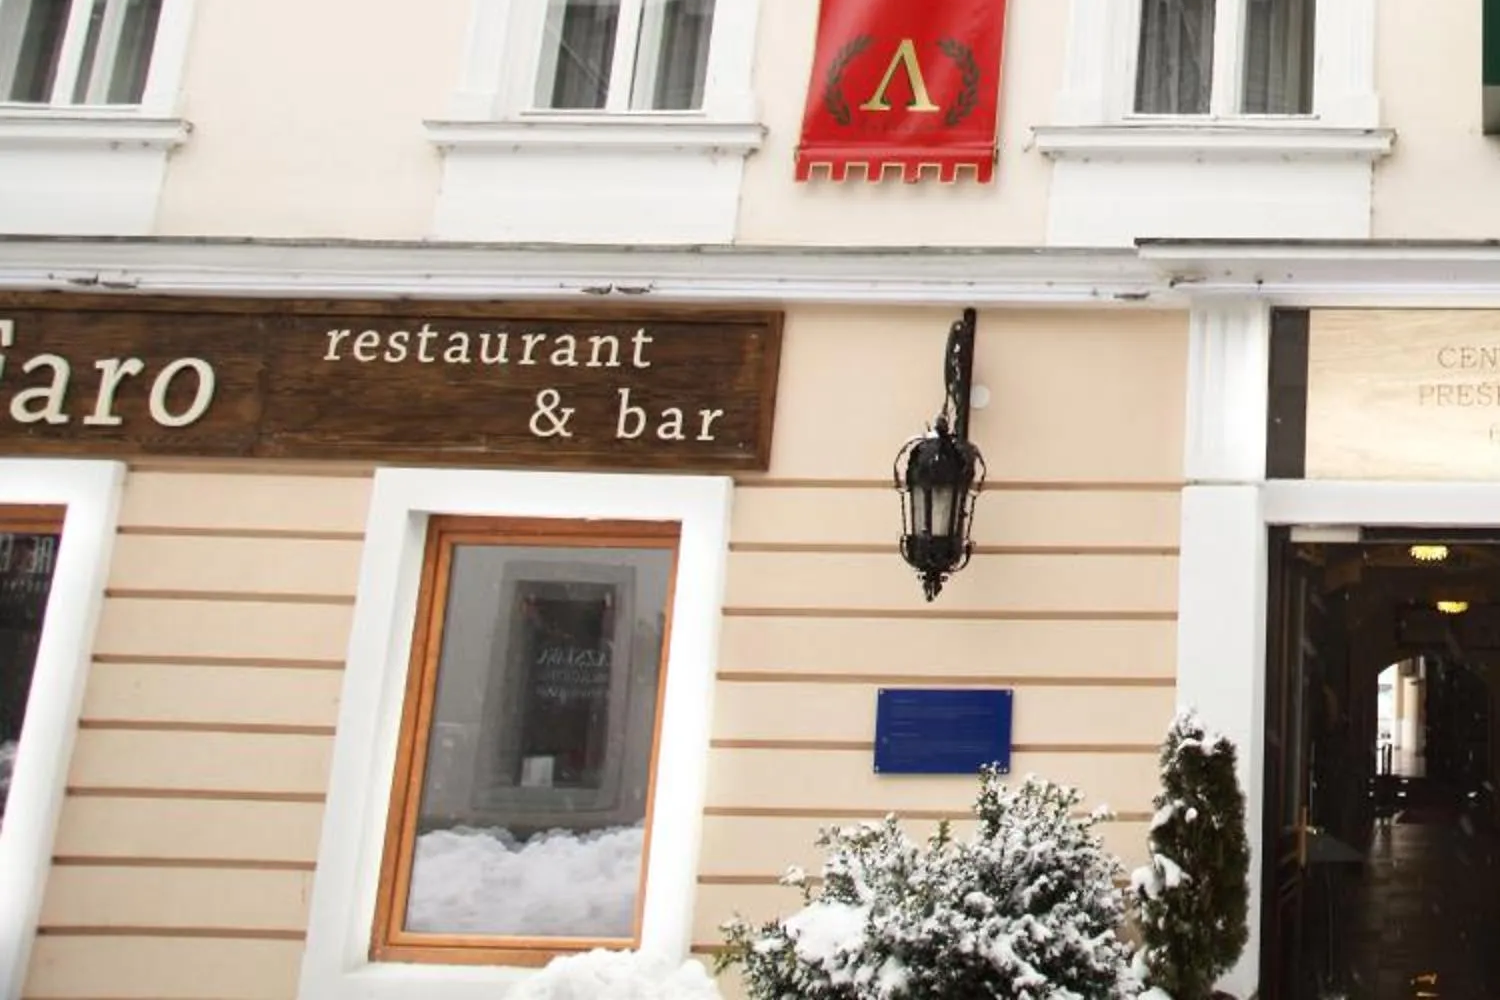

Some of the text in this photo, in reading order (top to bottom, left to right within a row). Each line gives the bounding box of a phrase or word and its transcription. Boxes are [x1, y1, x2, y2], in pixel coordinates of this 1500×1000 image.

[324, 322, 655, 369] restaurant
[528, 389, 724, 441] & bar
